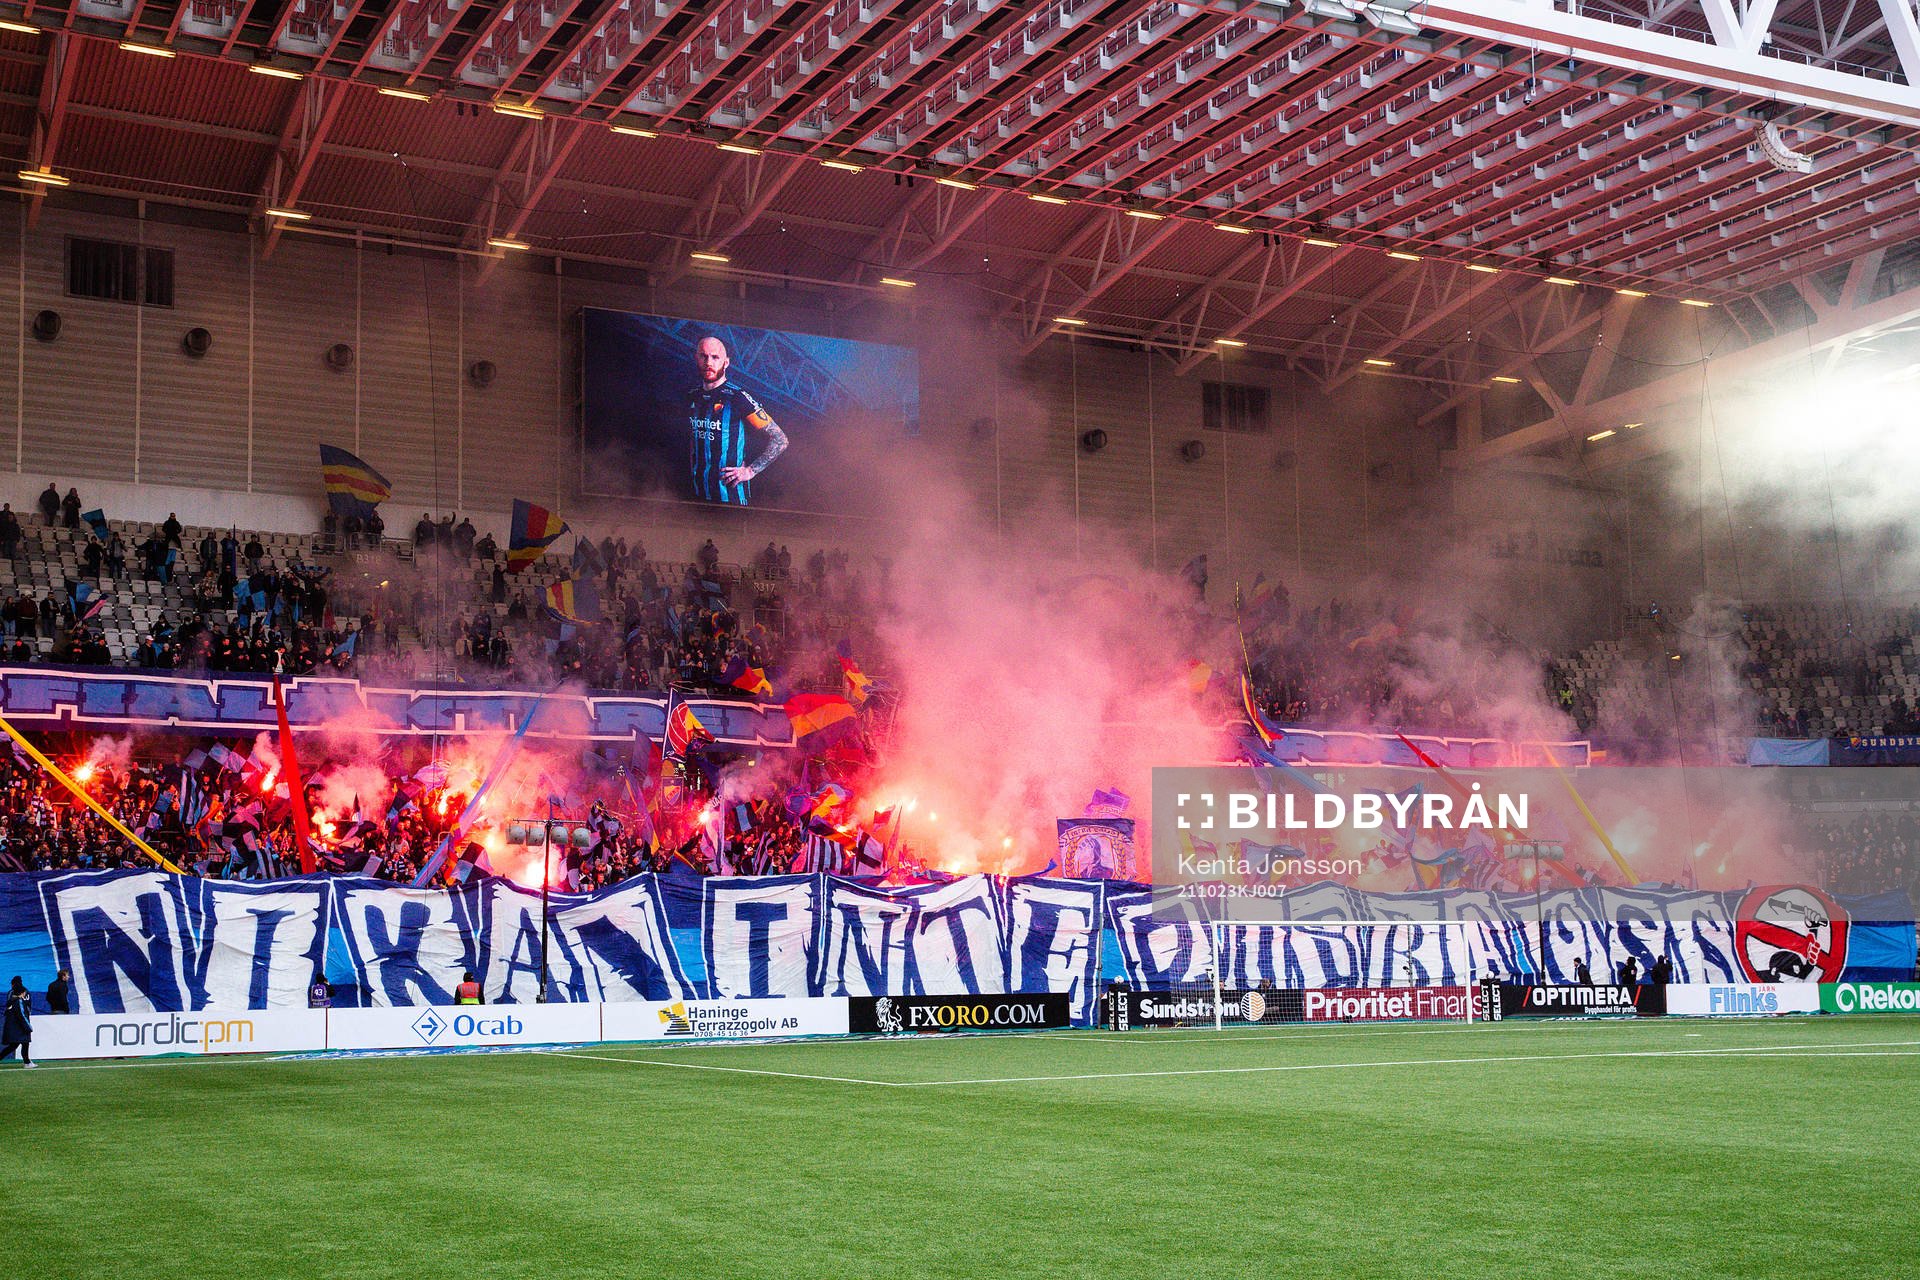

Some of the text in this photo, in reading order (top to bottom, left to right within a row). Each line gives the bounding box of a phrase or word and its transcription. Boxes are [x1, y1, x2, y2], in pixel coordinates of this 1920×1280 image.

[708, 875, 1094, 1016] INTE
[1117, 991, 1129, 1031] SELECT
[1305, 991, 1413, 1019] Prioritet
[1481, 984, 1490, 1021] SELECT
[1491, 983, 1502, 1021] SELECT
[1709, 987, 1778, 1012] Flinks
[453, 1014, 523, 1036] Ocab
[688, 1006, 749, 1021] Haninge
[689, 1018, 798, 1033] Terrazzogolv AB
[908, 1003, 1046, 1027] FXORO.COM
